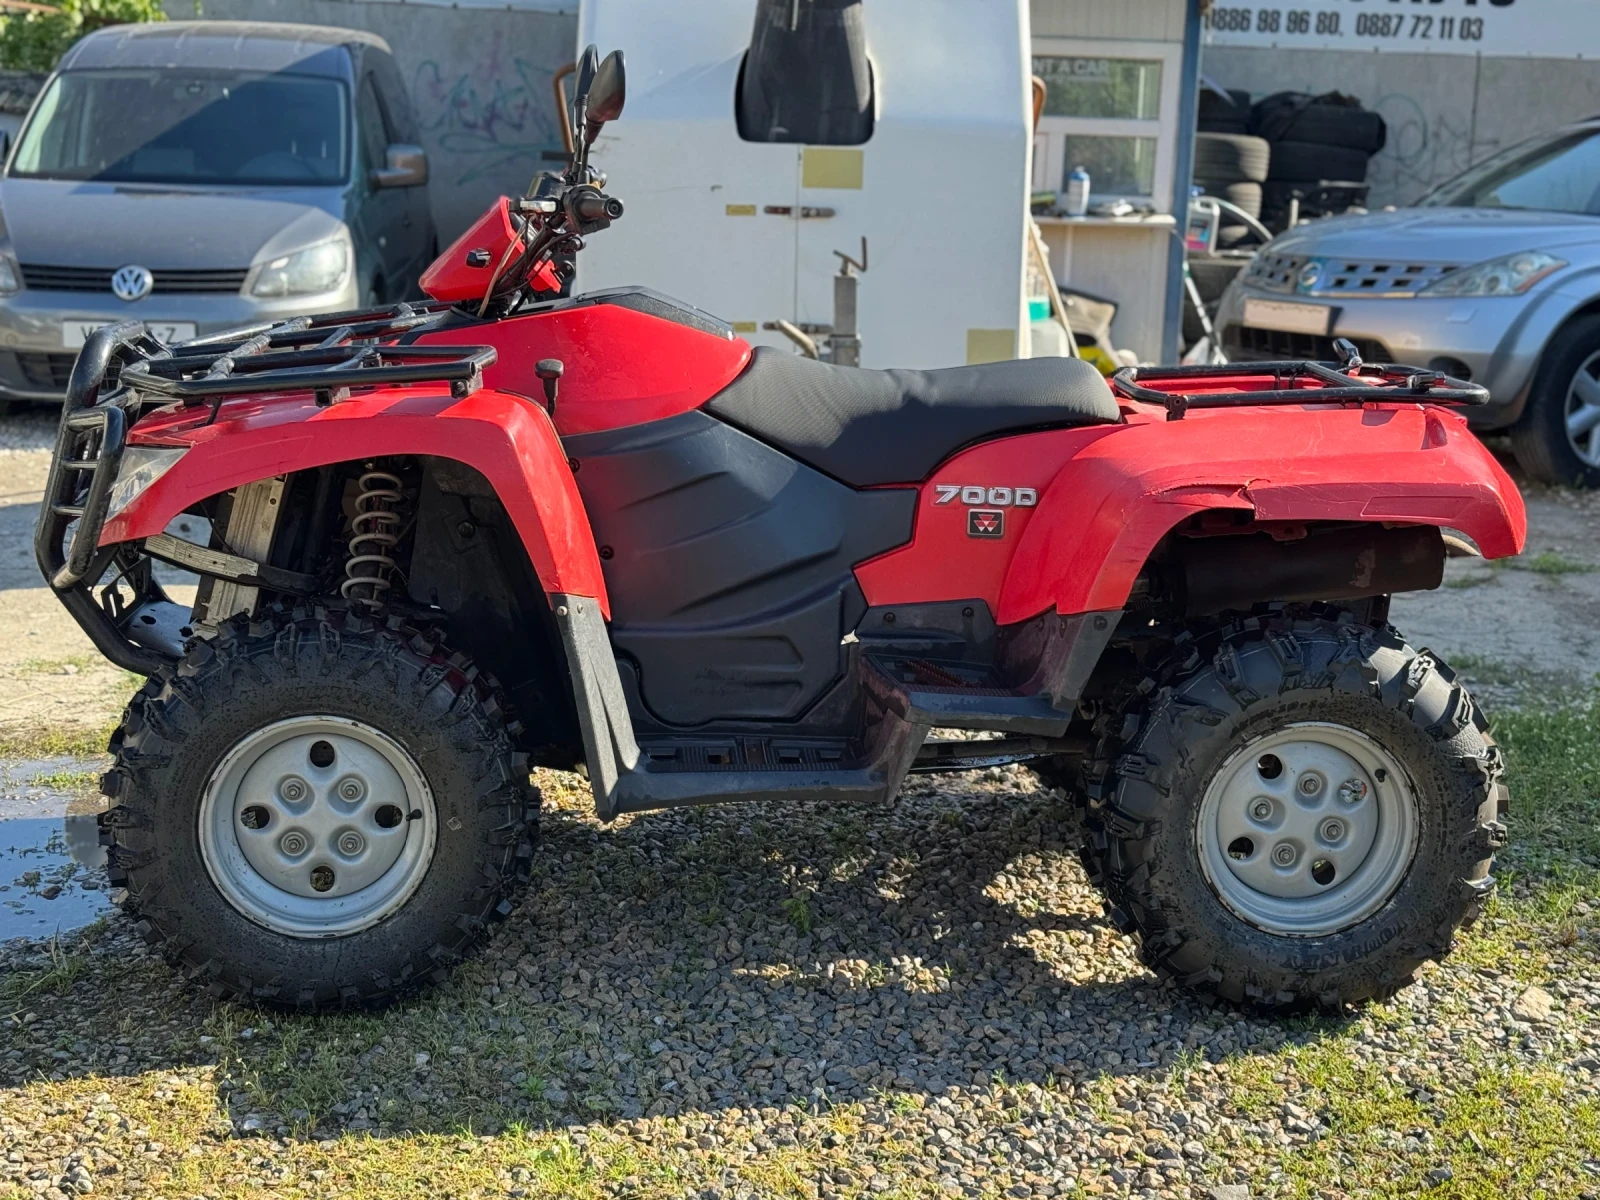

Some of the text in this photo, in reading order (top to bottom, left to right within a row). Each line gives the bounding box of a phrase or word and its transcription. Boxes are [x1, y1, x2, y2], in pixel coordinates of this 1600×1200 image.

[1257, 9, 1280, 33] 98
[1286, 10, 1310, 34] 96
[1355, 12, 1404, 38] 0887
[1409, 14, 1433, 39] 72
[1440, 15, 1454, 40] 11
[1459, 17, 1484, 41] 03
[1057, 59, 1071, 74] A
[1073, 60, 1109, 75] CAR
[935, 484, 1038, 506] 700D
